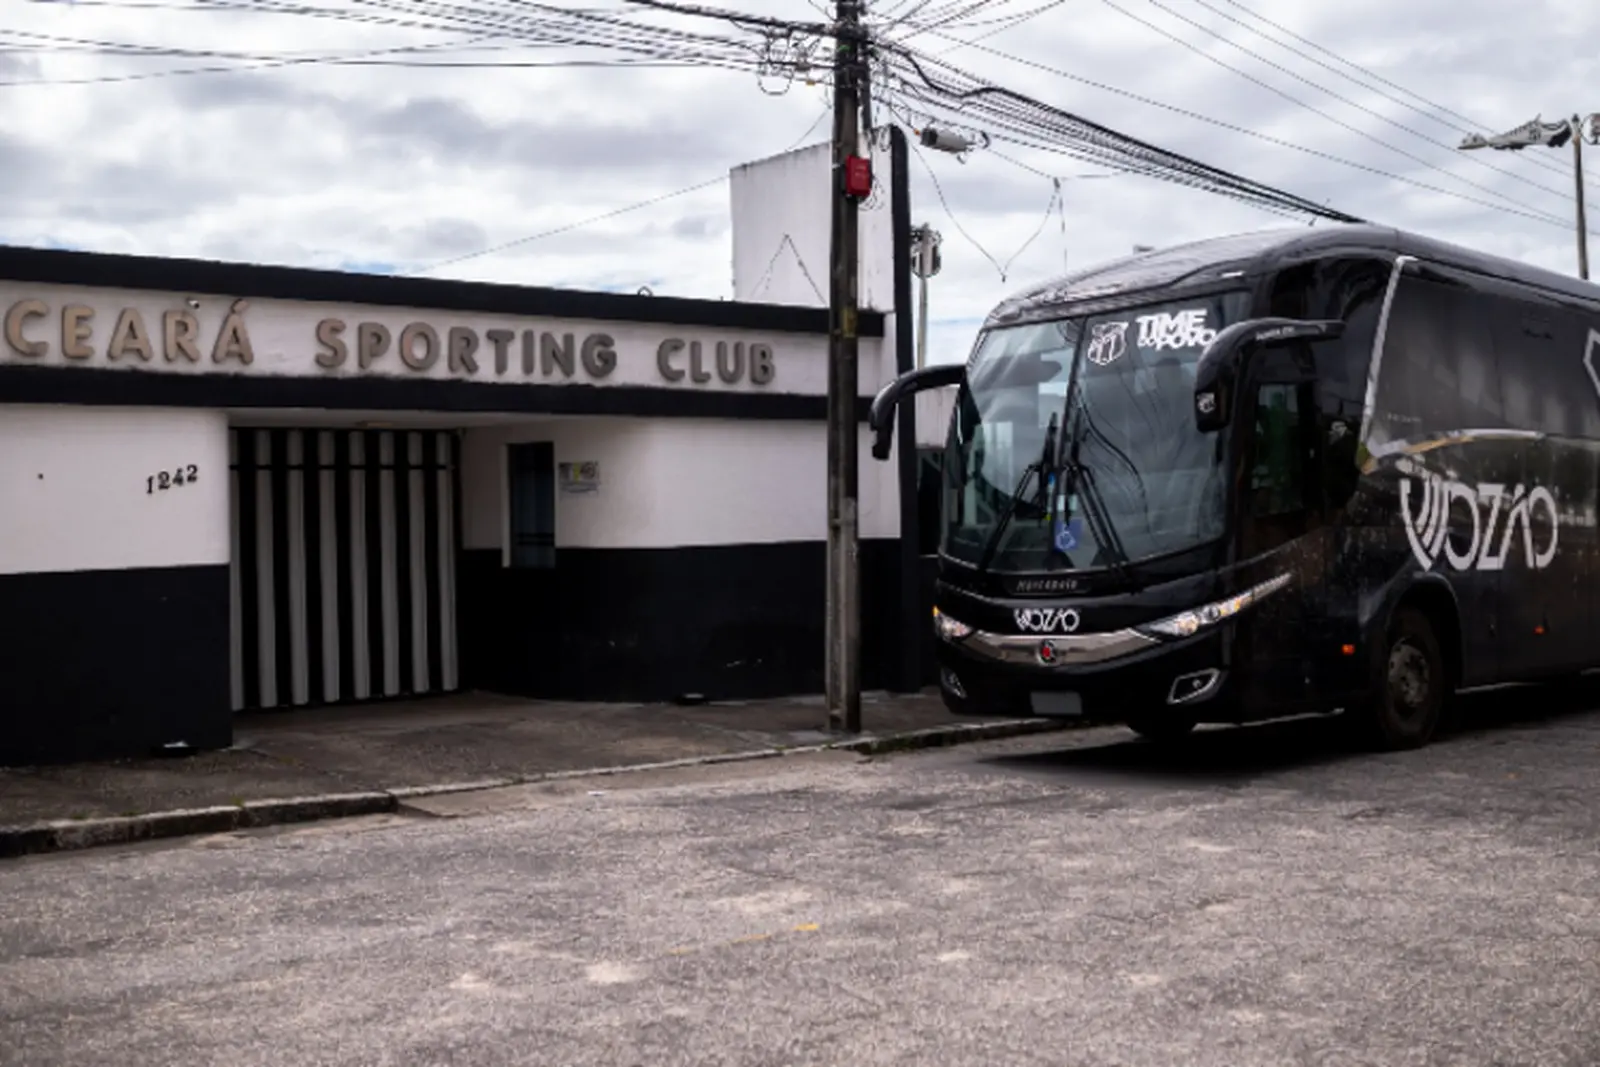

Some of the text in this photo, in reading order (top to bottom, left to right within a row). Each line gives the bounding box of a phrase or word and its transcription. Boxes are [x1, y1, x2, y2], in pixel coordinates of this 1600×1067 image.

[1135, 308, 1208, 341] TIME
[3, 298, 777, 385] CEARÁ SPORTING CLUB
[146, 463, 199, 495] 1242
